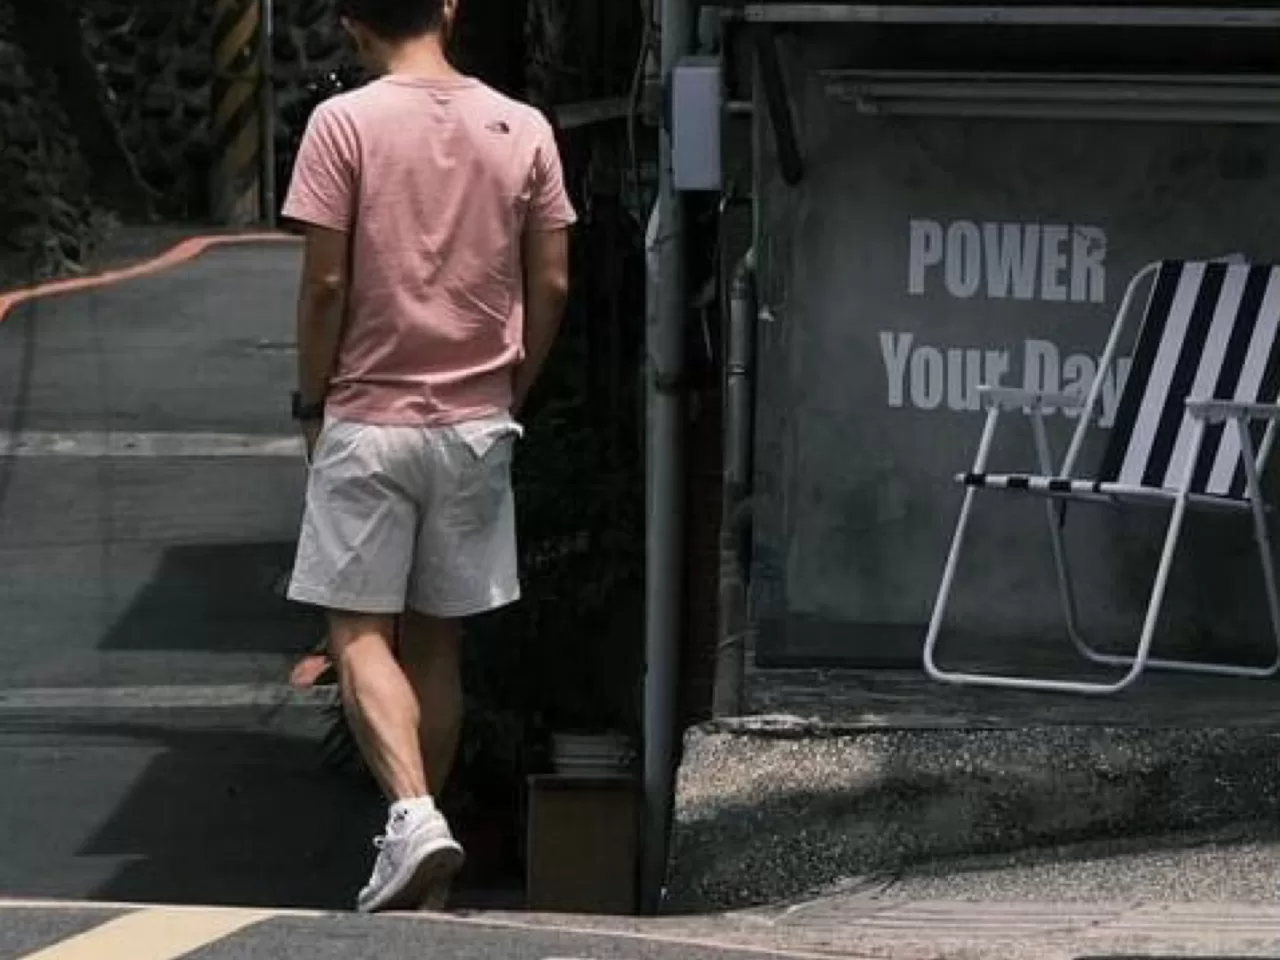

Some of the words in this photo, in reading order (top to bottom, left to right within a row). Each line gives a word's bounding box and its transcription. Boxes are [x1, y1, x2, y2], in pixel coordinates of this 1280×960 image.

[907, 218, 1108, 304] POWER
[879, 331, 1011, 411] Your
[1022, 338, 1134, 429] Day
